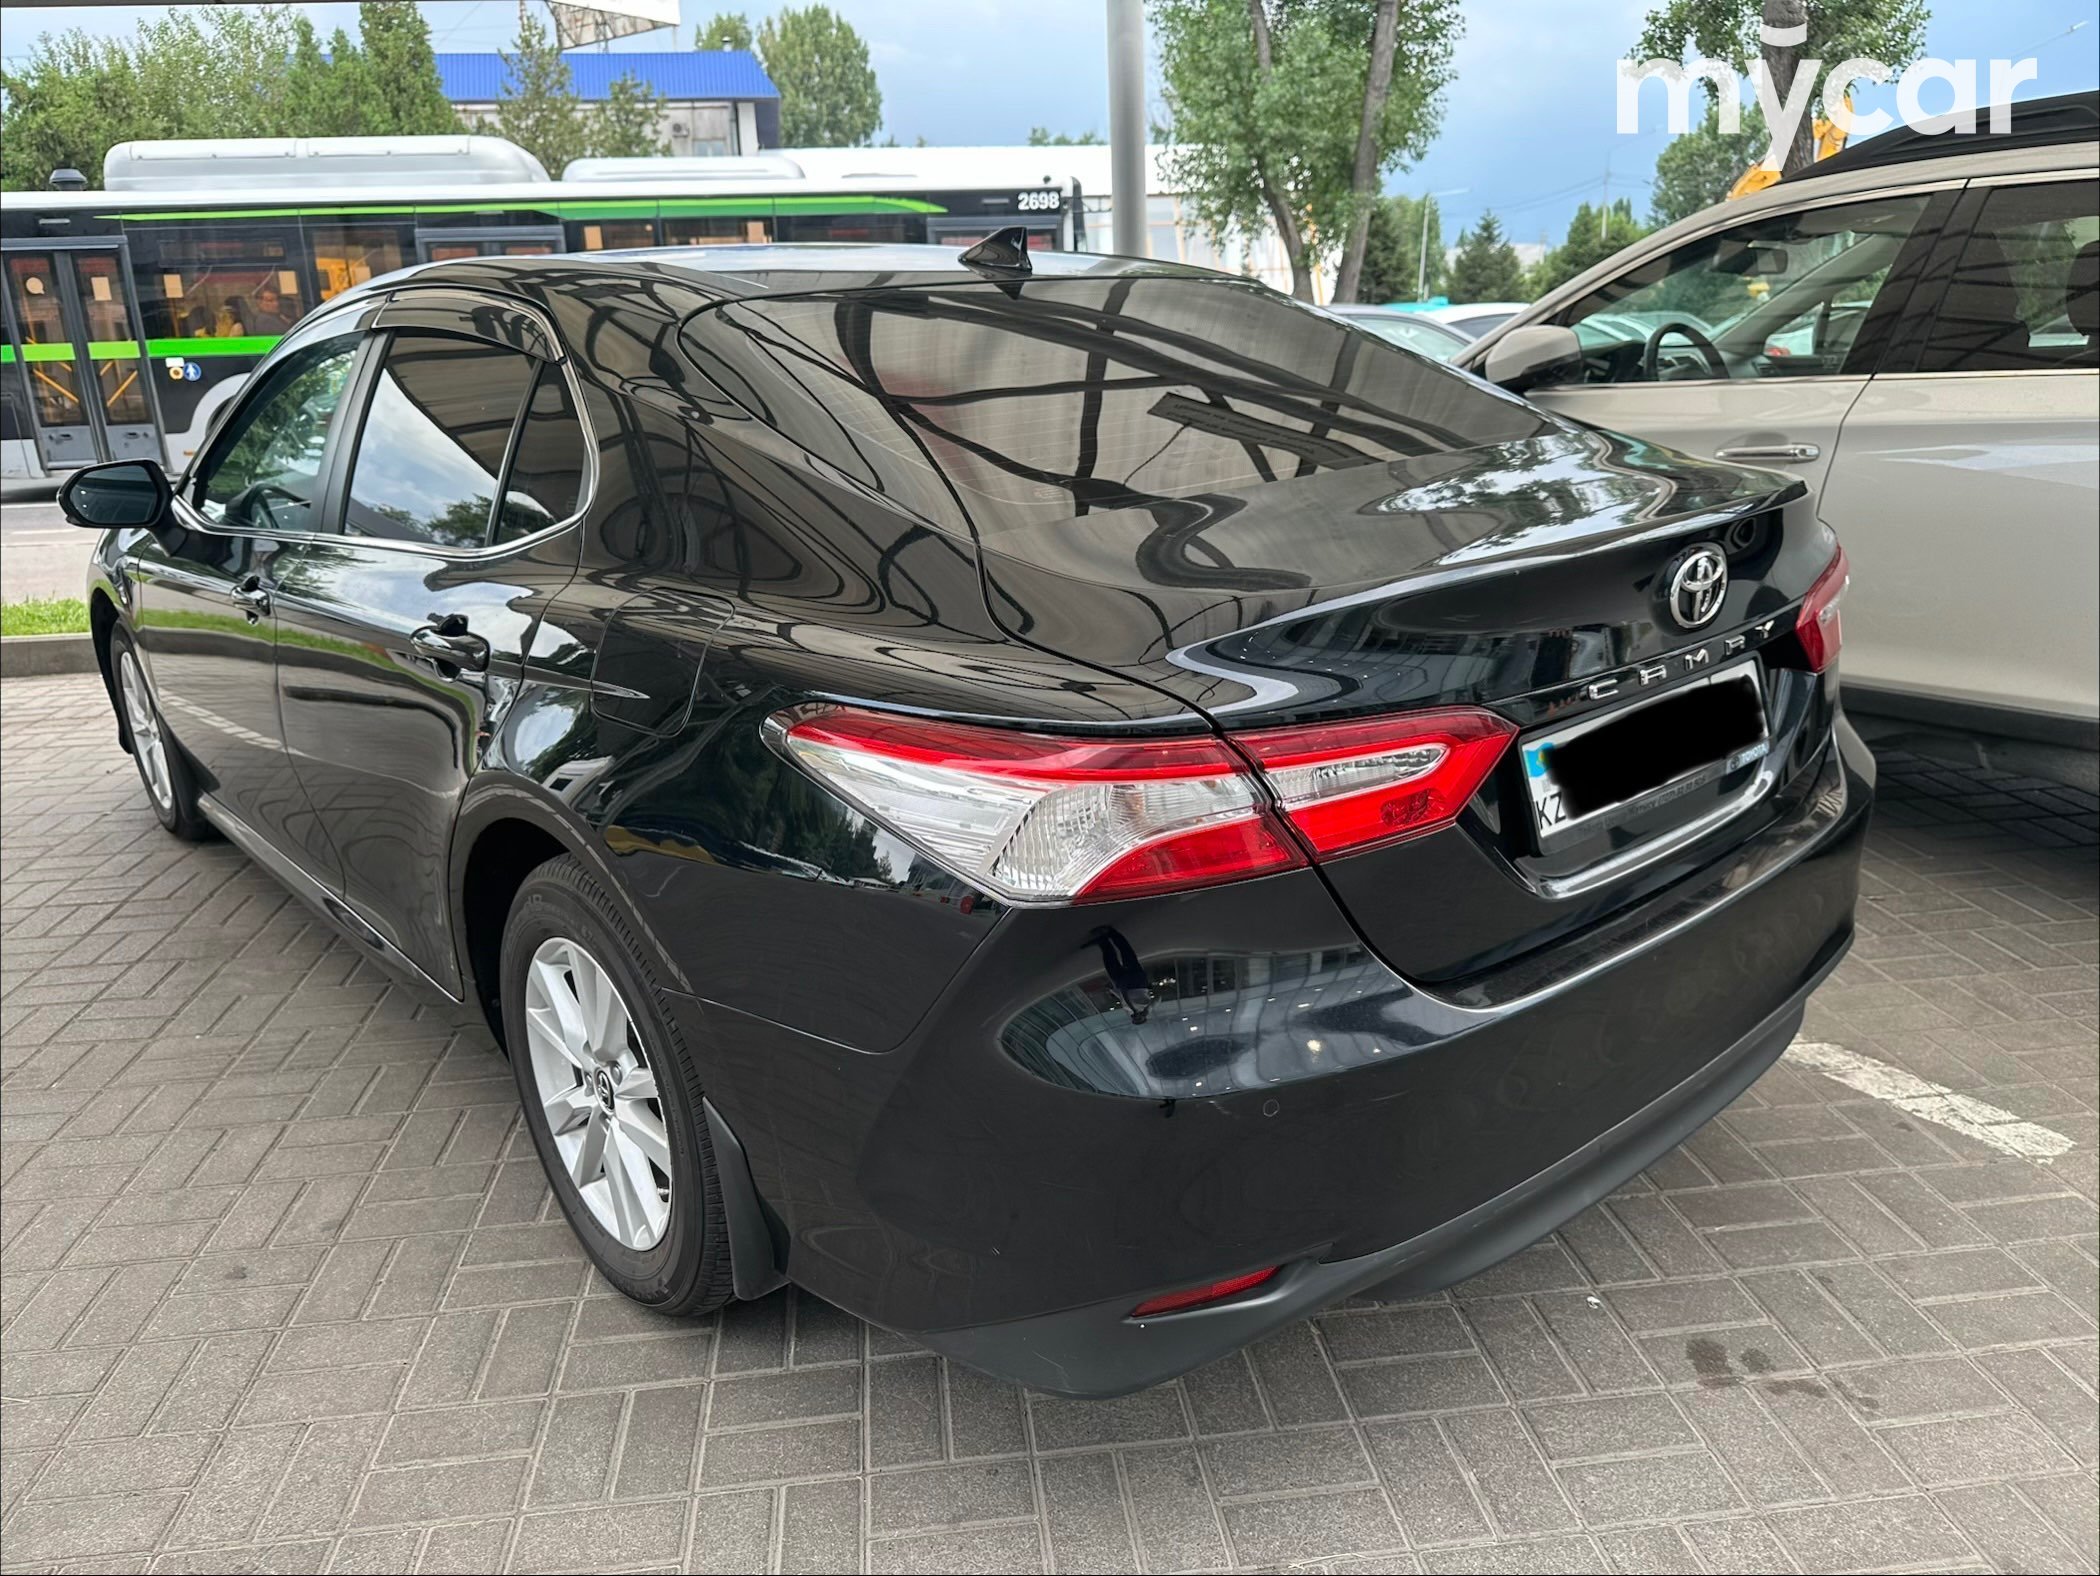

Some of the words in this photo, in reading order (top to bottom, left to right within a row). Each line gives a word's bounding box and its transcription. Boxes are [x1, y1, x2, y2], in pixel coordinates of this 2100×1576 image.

[1017, 191, 1060, 210] 2698
[1588, 620, 1775, 700] CAMRY
[1535, 791, 1567, 830] KZ
